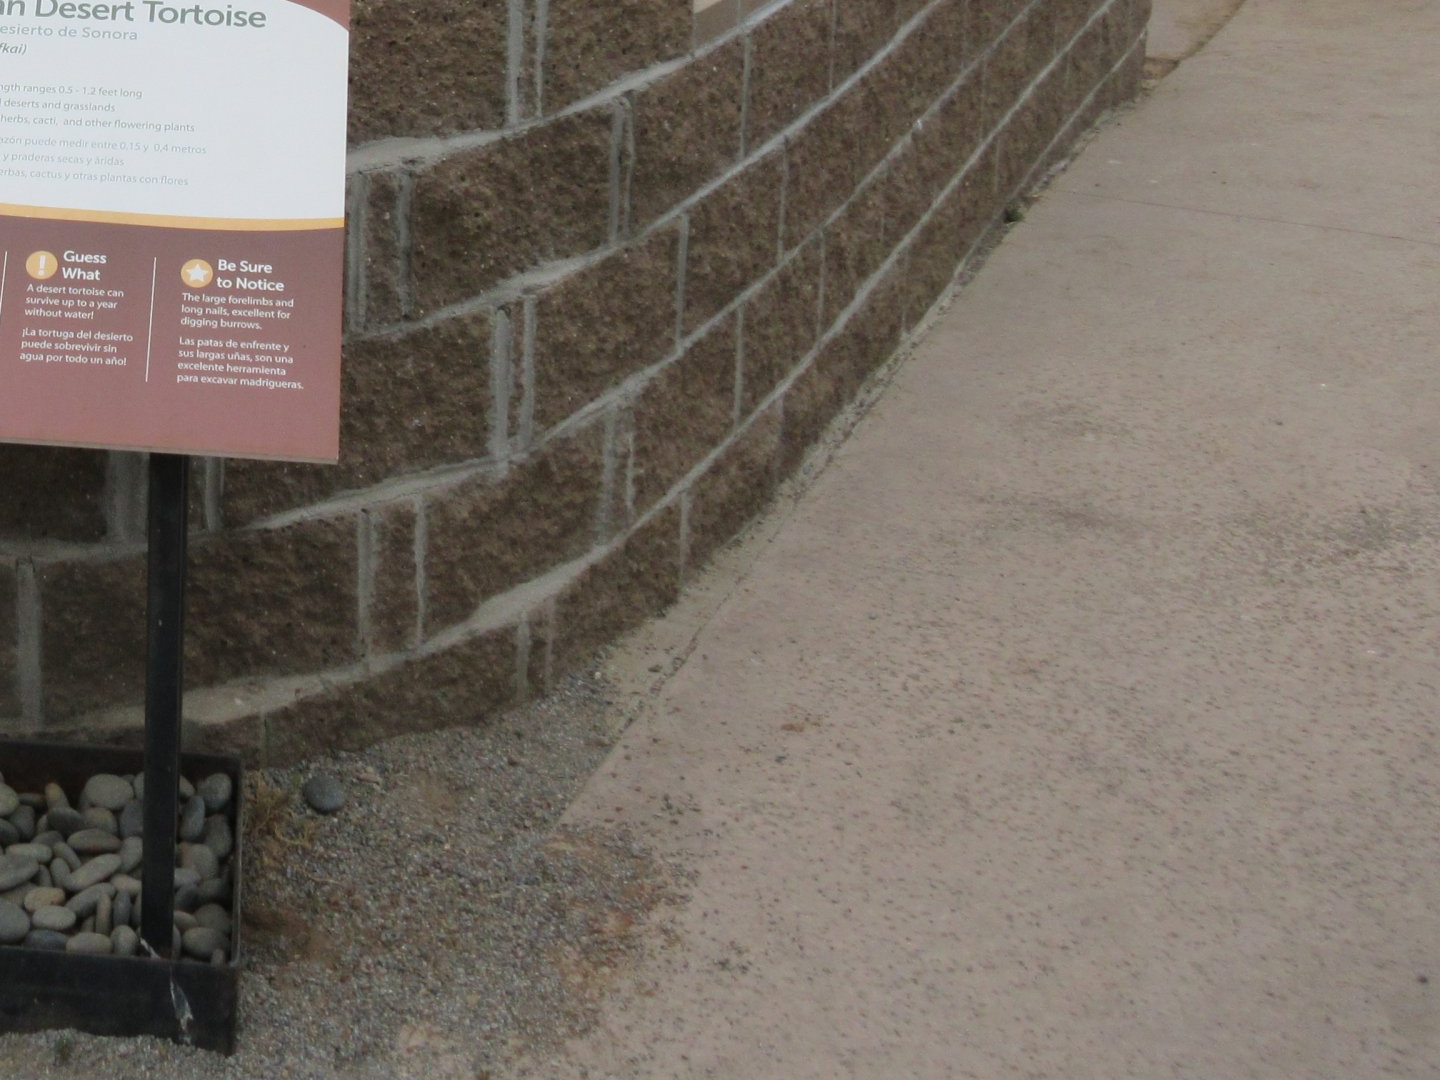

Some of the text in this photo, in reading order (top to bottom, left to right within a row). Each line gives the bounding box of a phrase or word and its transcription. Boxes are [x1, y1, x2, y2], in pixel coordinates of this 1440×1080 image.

[141, 0, 266, 28] Tortoise
[57, 25, 77, 38] de
[81, 26, 138, 40] Sonora
[22, 85, 56, 95] ranges
[57, 84, 73, 94] 0.5
[82, 86, 96, 95] 1.2
[98, 86, 118, 97] feet
[119, 87, 143, 100] long
[3, 97, 39, 109] deserts
[41, 100, 61, 109] and
[62, 102, 115, 112] grasslands
[62, 117, 83, 126] and
[84, 117, 112, 128] other
[113, 118, 162, 132] flowering
[163, 121, 195, 133] plants
[62, 249, 107, 264] Guess
[61, 266, 100, 281] What
[217, 258, 273, 274] Be Sure
[26, 282, 124, 297] A desert tortoise can
[216, 276, 285, 292] to Notice
[25, 296, 118, 310] survive up to a year
[181, 291, 294, 307] The large forelimbs and
[24, 307, 62, 317] without
[180, 303, 203, 316] long
[231, 307, 275, 318] excellent
[276, 309, 290, 319] for
[179, 315, 218, 329] digging
[38, 328, 74, 340] tortuga
[75, 329, 92, 339] del
[93, 330, 133, 342] desierto
[20, 339, 117, 353] puede sobrevivir sin
[178, 335, 290, 353] Las patas de enfrente y
[19, 352, 44, 362] agua
[45, 354, 63, 363] por
[64, 353, 88, 364] todo
[89, 356, 103, 364] un
[178, 349, 194, 358] sus
[195, 348, 225, 361] largas
[254, 354, 273, 363] son
[274, 355, 294, 364] una
[177, 361, 286, 376] excelente herramienta
[176, 374, 199, 384] para
[200, 375, 238, 385] excavar
